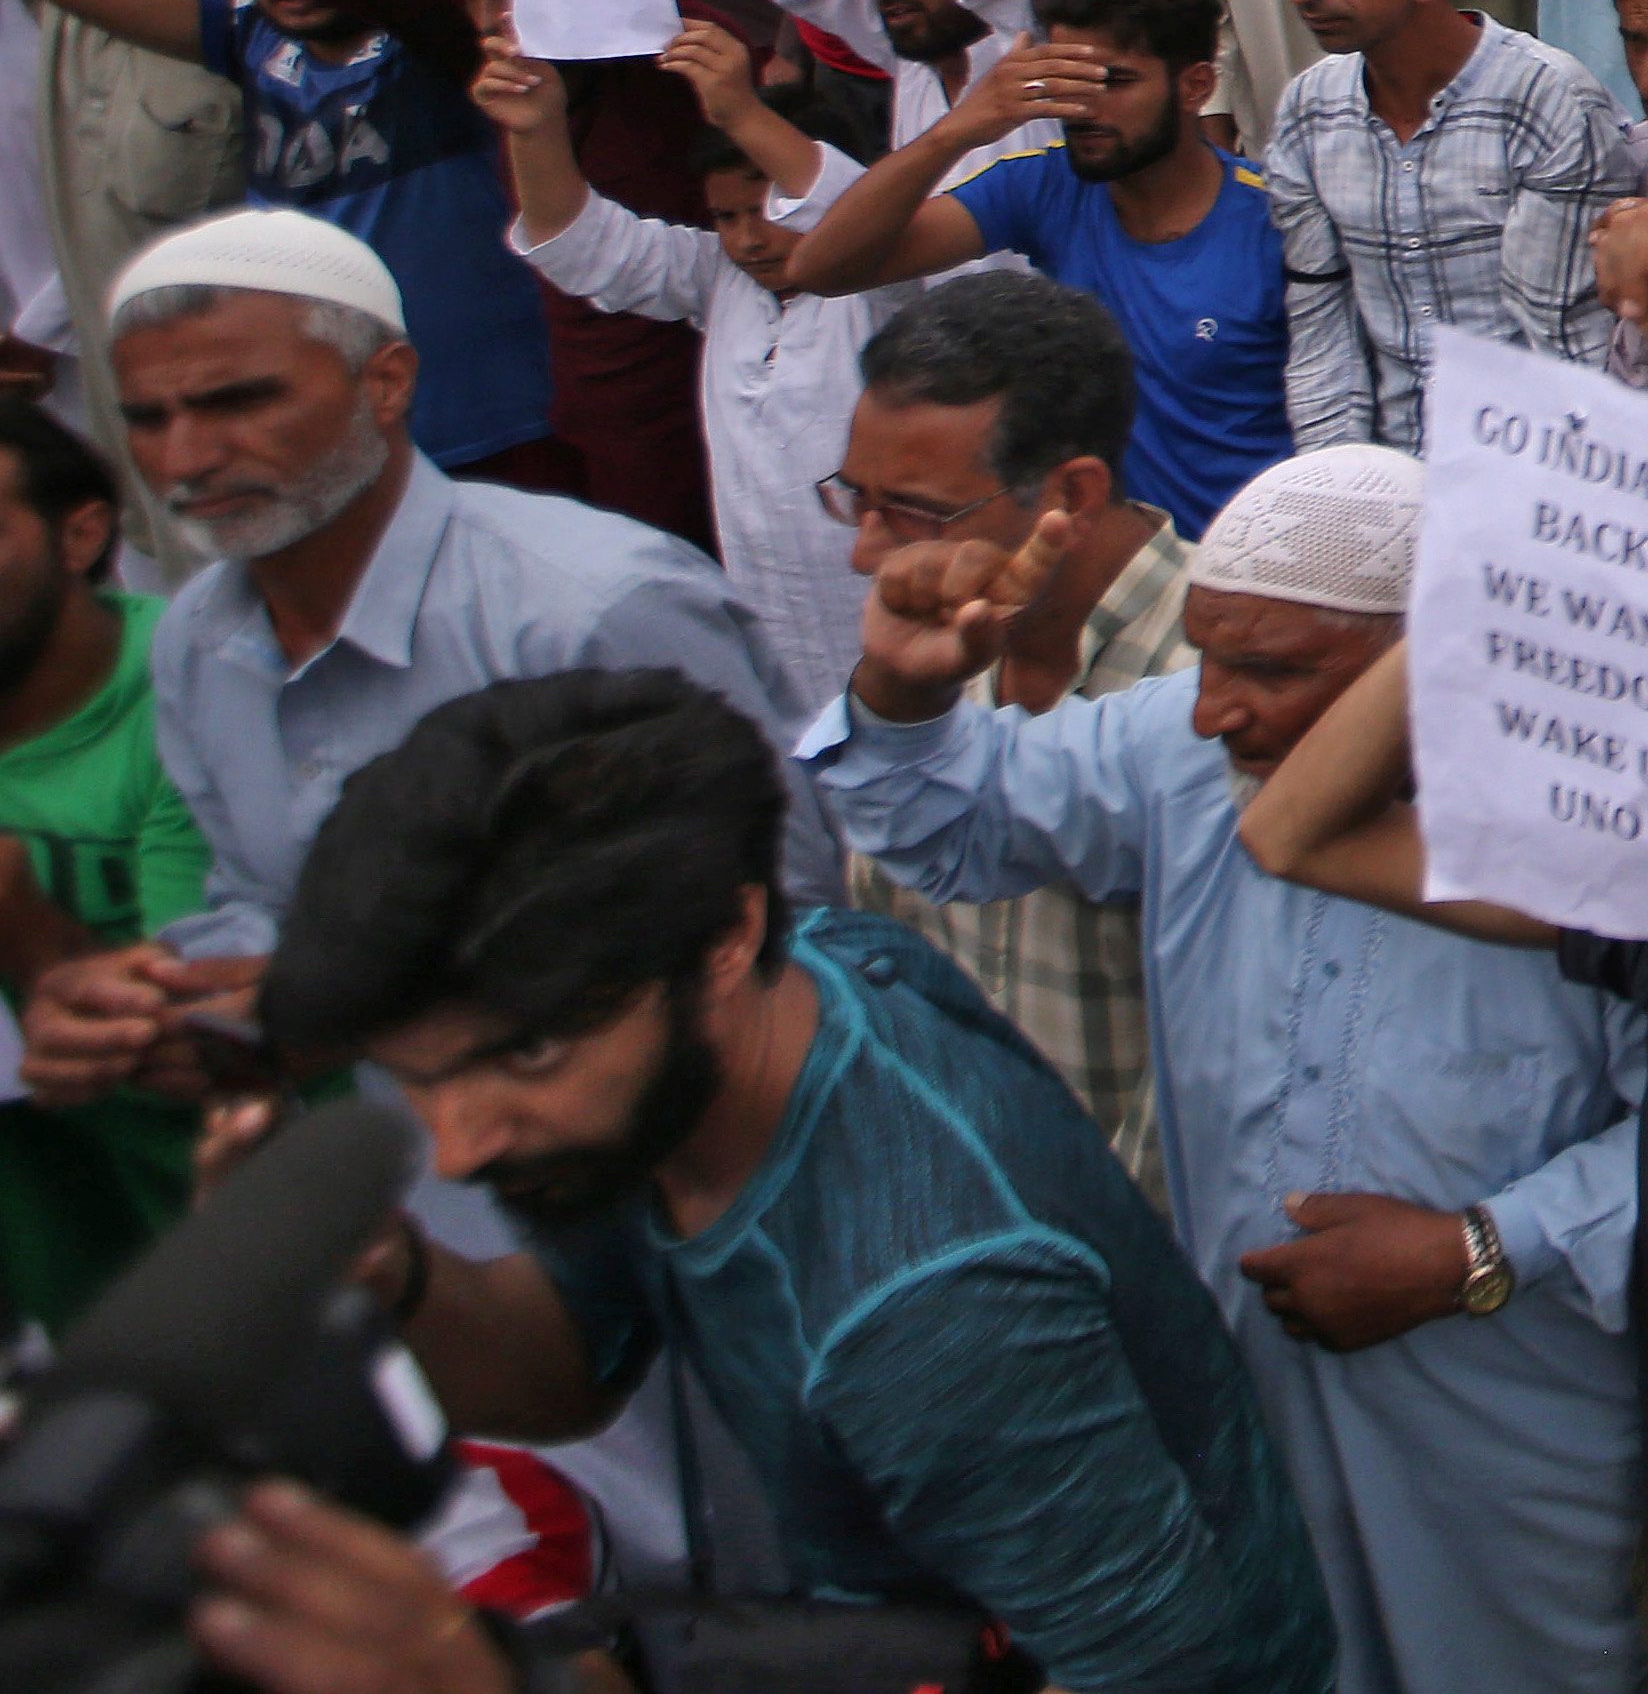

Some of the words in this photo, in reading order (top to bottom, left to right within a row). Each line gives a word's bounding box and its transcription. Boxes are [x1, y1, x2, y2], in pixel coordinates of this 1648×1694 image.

[1474, 405, 1530, 457] GO
[1482, 563, 1551, 617] WE
[1494, 701, 1627, 773] WAKE
[1549, 783, 1641, 842] UNO
